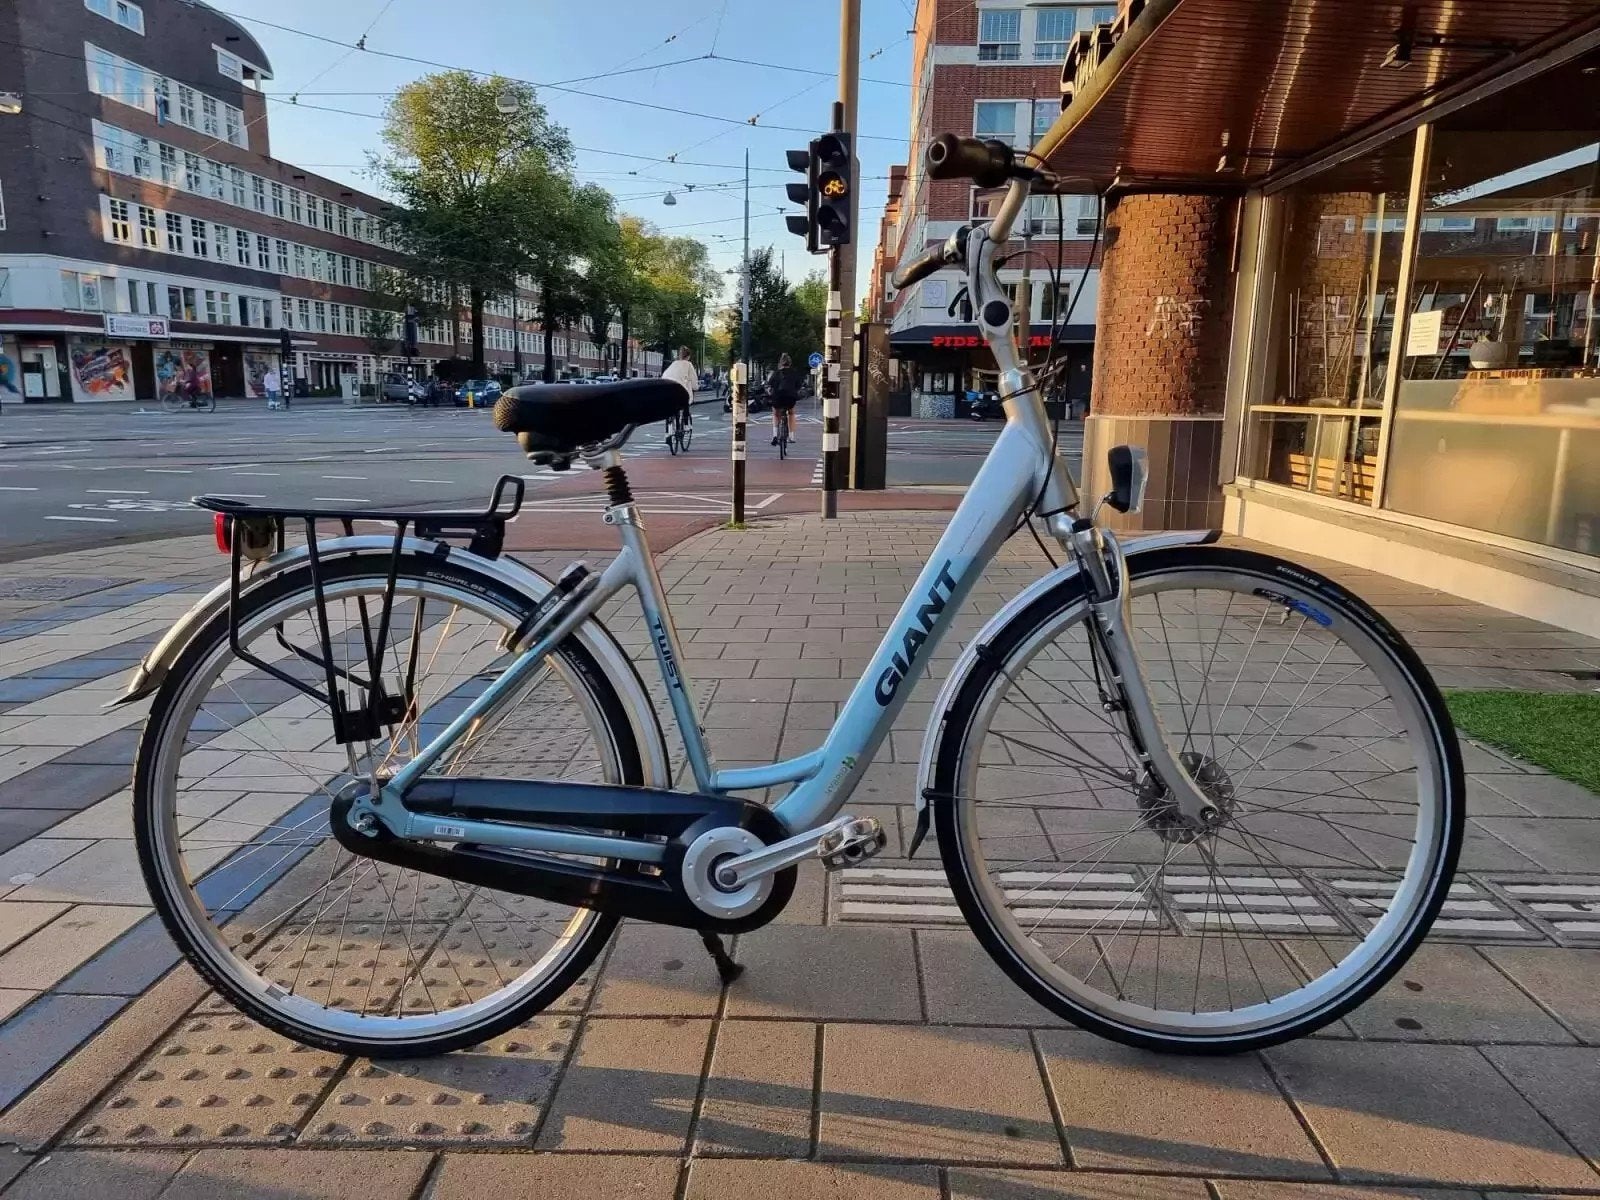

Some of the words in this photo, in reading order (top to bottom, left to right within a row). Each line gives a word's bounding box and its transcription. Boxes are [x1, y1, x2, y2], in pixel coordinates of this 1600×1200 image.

[933, 336, 978, 347] PIDE
[653, 616, 684, 693] TWIST
[875, 560, 957, 706] GIANT
